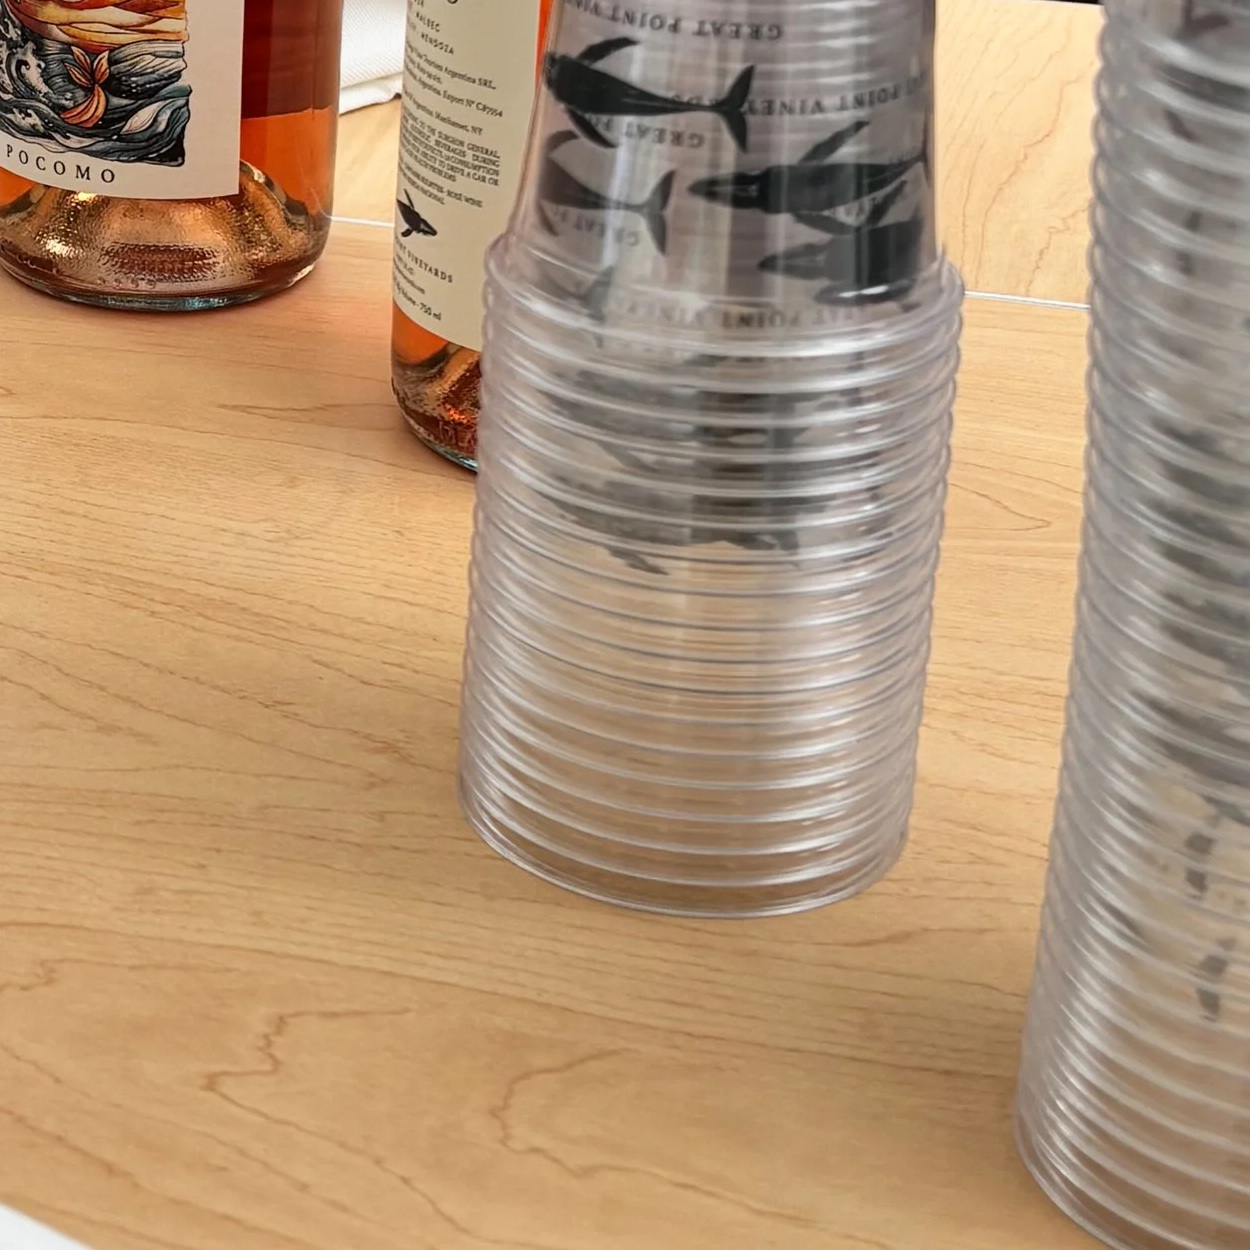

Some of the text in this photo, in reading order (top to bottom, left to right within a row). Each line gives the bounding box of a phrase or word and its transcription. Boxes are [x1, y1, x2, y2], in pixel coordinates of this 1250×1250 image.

[608, 6, 682, 35] POINT
[694, 19, 784, 42] GREAT
[835, 84, 900, 113] POINT
[6, 143, 117, 185] POCOMO
